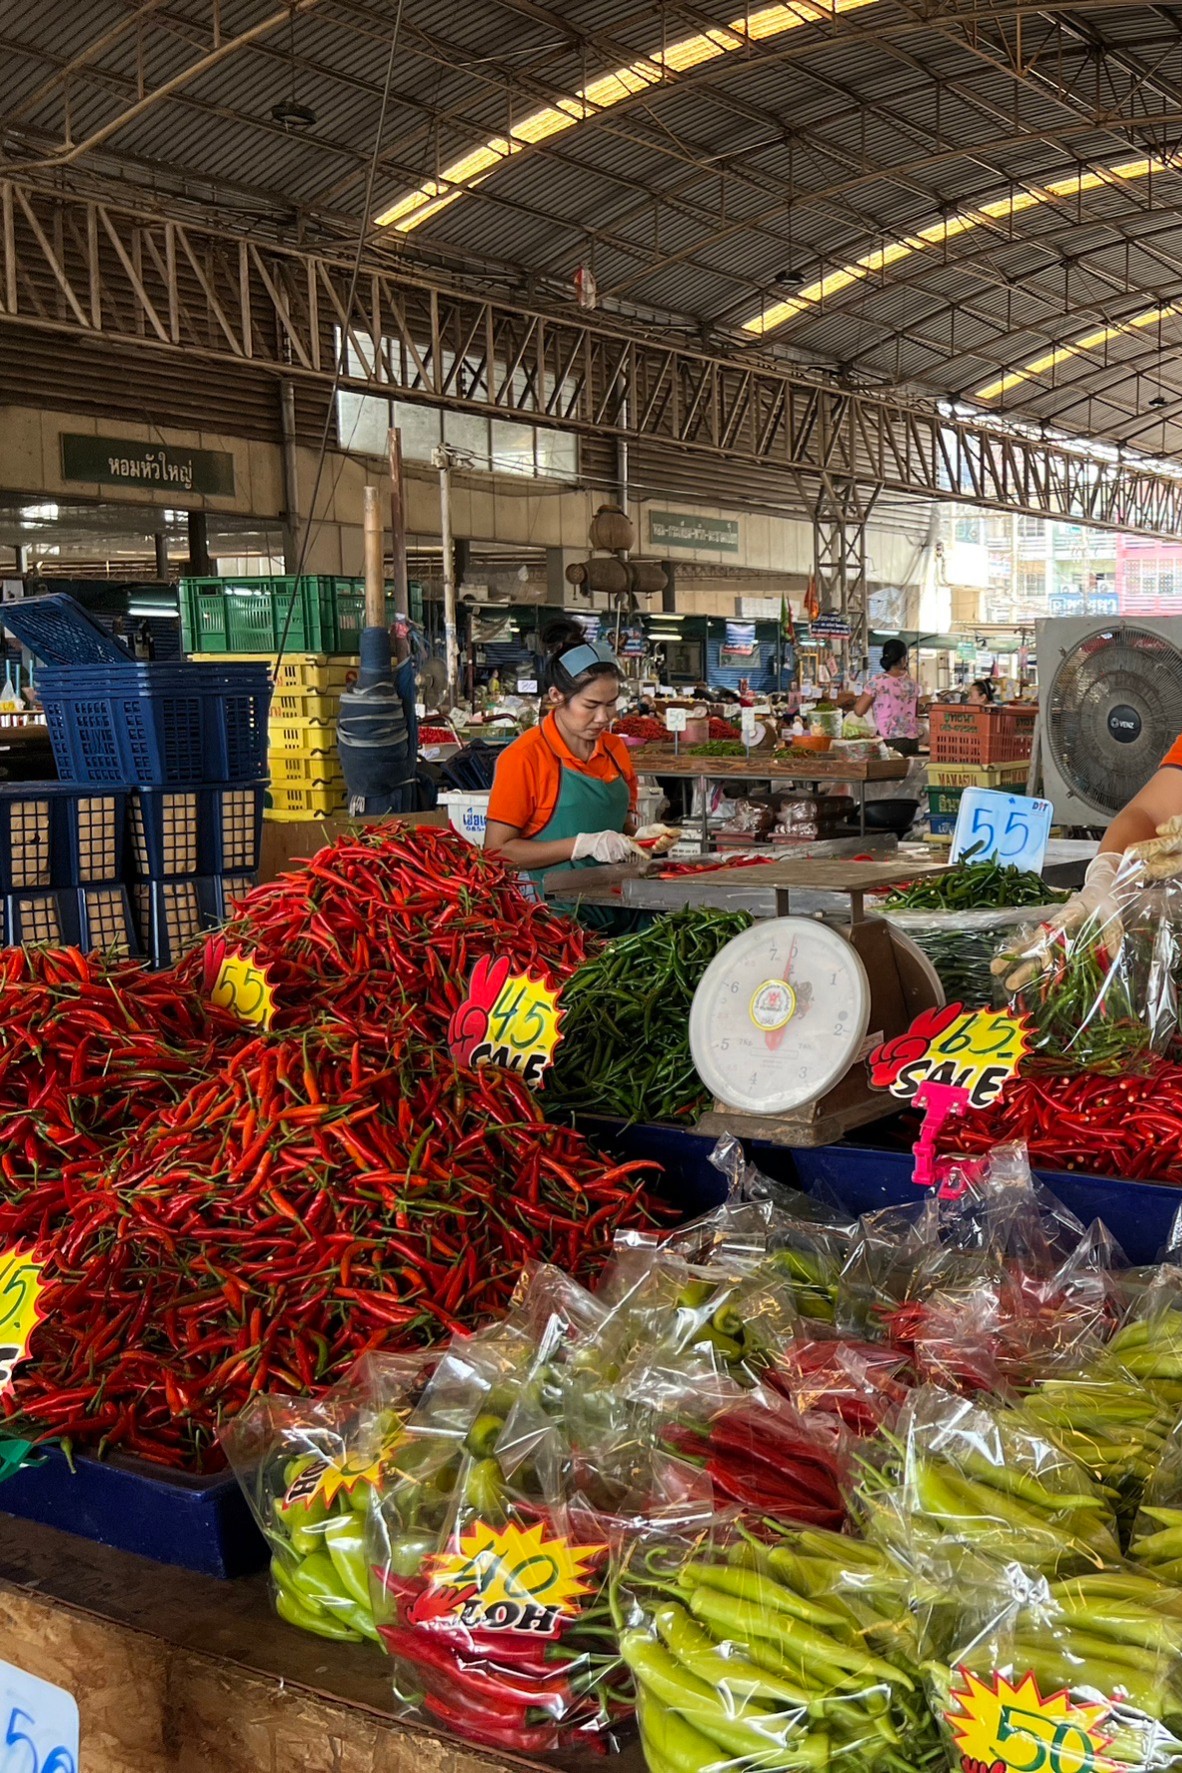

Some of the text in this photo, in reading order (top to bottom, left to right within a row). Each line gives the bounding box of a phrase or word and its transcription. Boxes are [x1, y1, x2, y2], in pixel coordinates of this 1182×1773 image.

[108, 452, 193, 489] หอมหัวใหญ่
[669, 711, 684, 725] 50
[961, 807, 1030, 857] 55
[214, 964, 265, 1016] 55
[833, 1023, 844, 1036] 2
[989, 1703, 1095, 1773] 50
